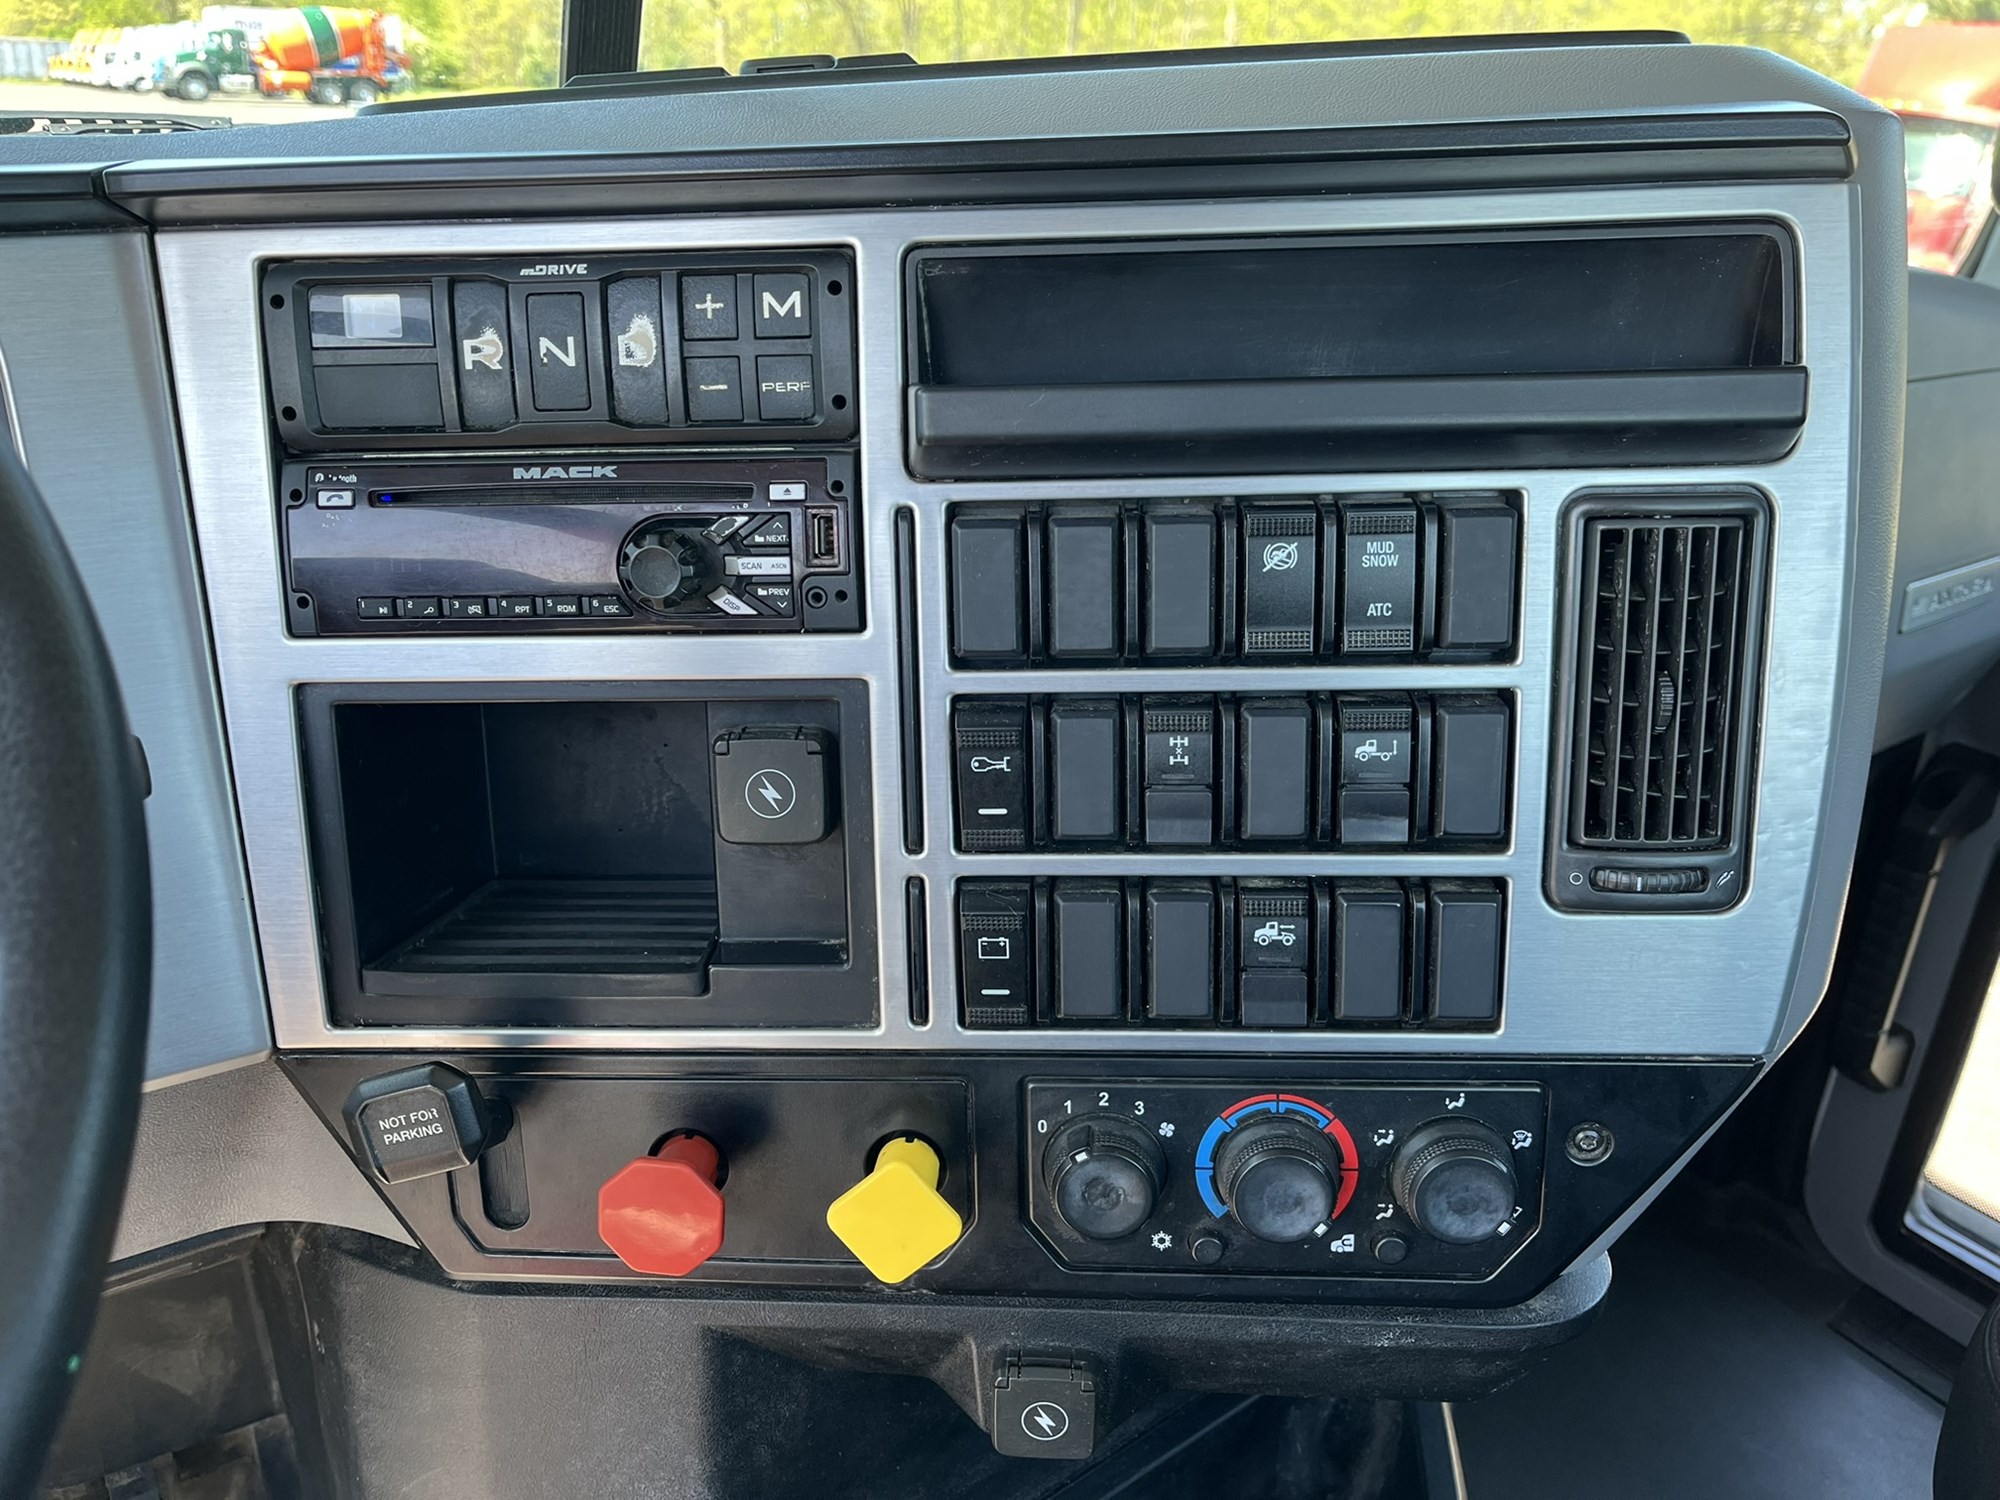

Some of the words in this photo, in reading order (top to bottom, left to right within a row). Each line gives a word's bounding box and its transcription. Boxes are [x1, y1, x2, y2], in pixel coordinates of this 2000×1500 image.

[519, 263, 588, 276] mDRIVE
[762, 290, 802, 319] M
[463, 334, 503, 370] R
[539, 335, 577, 368] N
[761, 381, 811, 393] PERF
[512, 465, 618, 480] MACK
[765, 534, 787, 543] NEXT
[1366, 541, 1395, 555] MUD
[740, 561, 763, 570] SCAN
[1361, 554, 1399, 568] SNOW
[768, 587, 790, 596] PREV
[361, 600, 366, 609] 1
[407, 600, 414, 609] 2
[453, 600, 460, 609] 3
[500, 600, 508, 608] 4
[514, 605, 531, 614] RPT
[546, 599, 554, 608] 5
[557, 604, 577, 613] RDM
[591, 599, 600, 608] 6
[603, 604, 621, 613] ESC
[722, 597, 742, 612] DISP
[1366, 603, 1393, 617] ATC
[1098, 1091, 1110, 1107] 2
[1063, 1100, 1072, 1114] 1
[1134, 1100, 1145, 1115] 3
[378, 1114, 407, 1131] NOT
[409, 1107, 439, 1125] FOR
[1037, 1119, 1048, 1134] 0
[383, 1123, 444, 1146] PARKING
